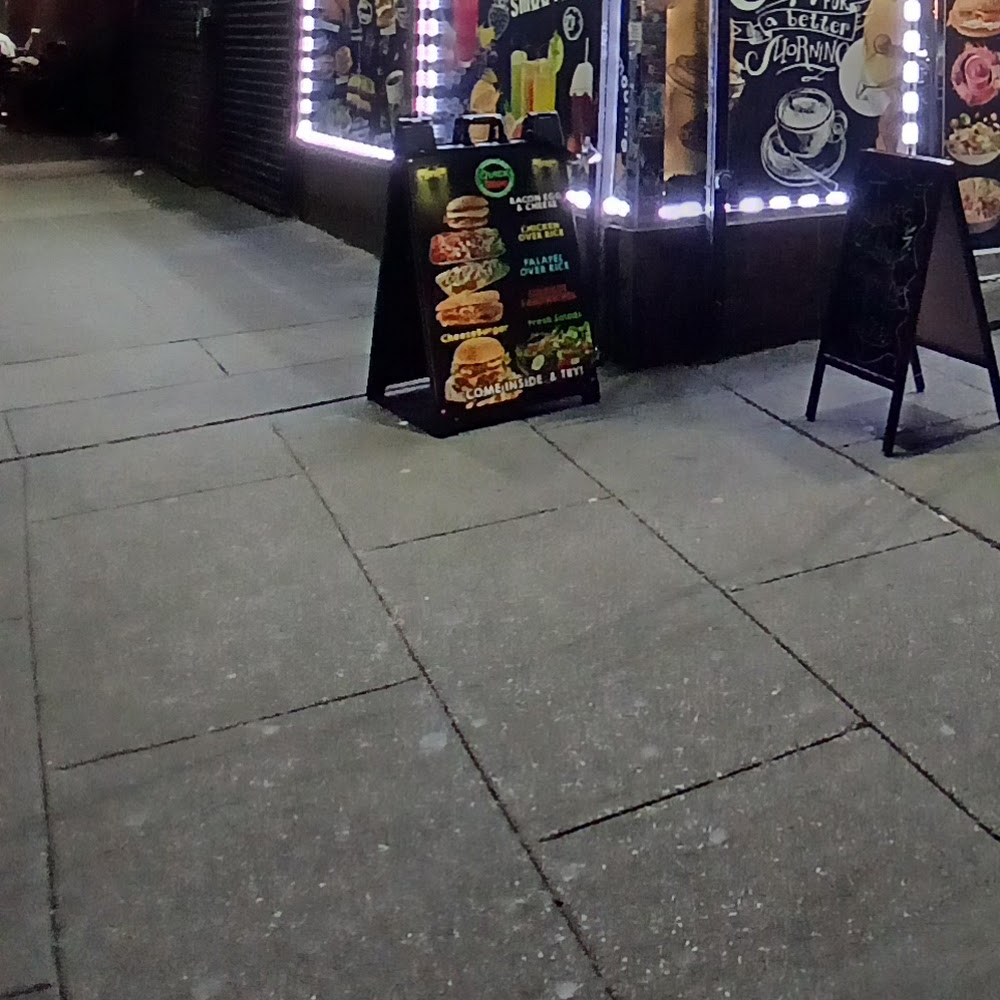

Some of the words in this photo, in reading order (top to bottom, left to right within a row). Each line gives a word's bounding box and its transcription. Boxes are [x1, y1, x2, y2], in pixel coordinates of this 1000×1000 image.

[786, 9, 851, 35] better
[466, 383, 502, 400] COME
[505, 374, 543, 391] INSIDE
